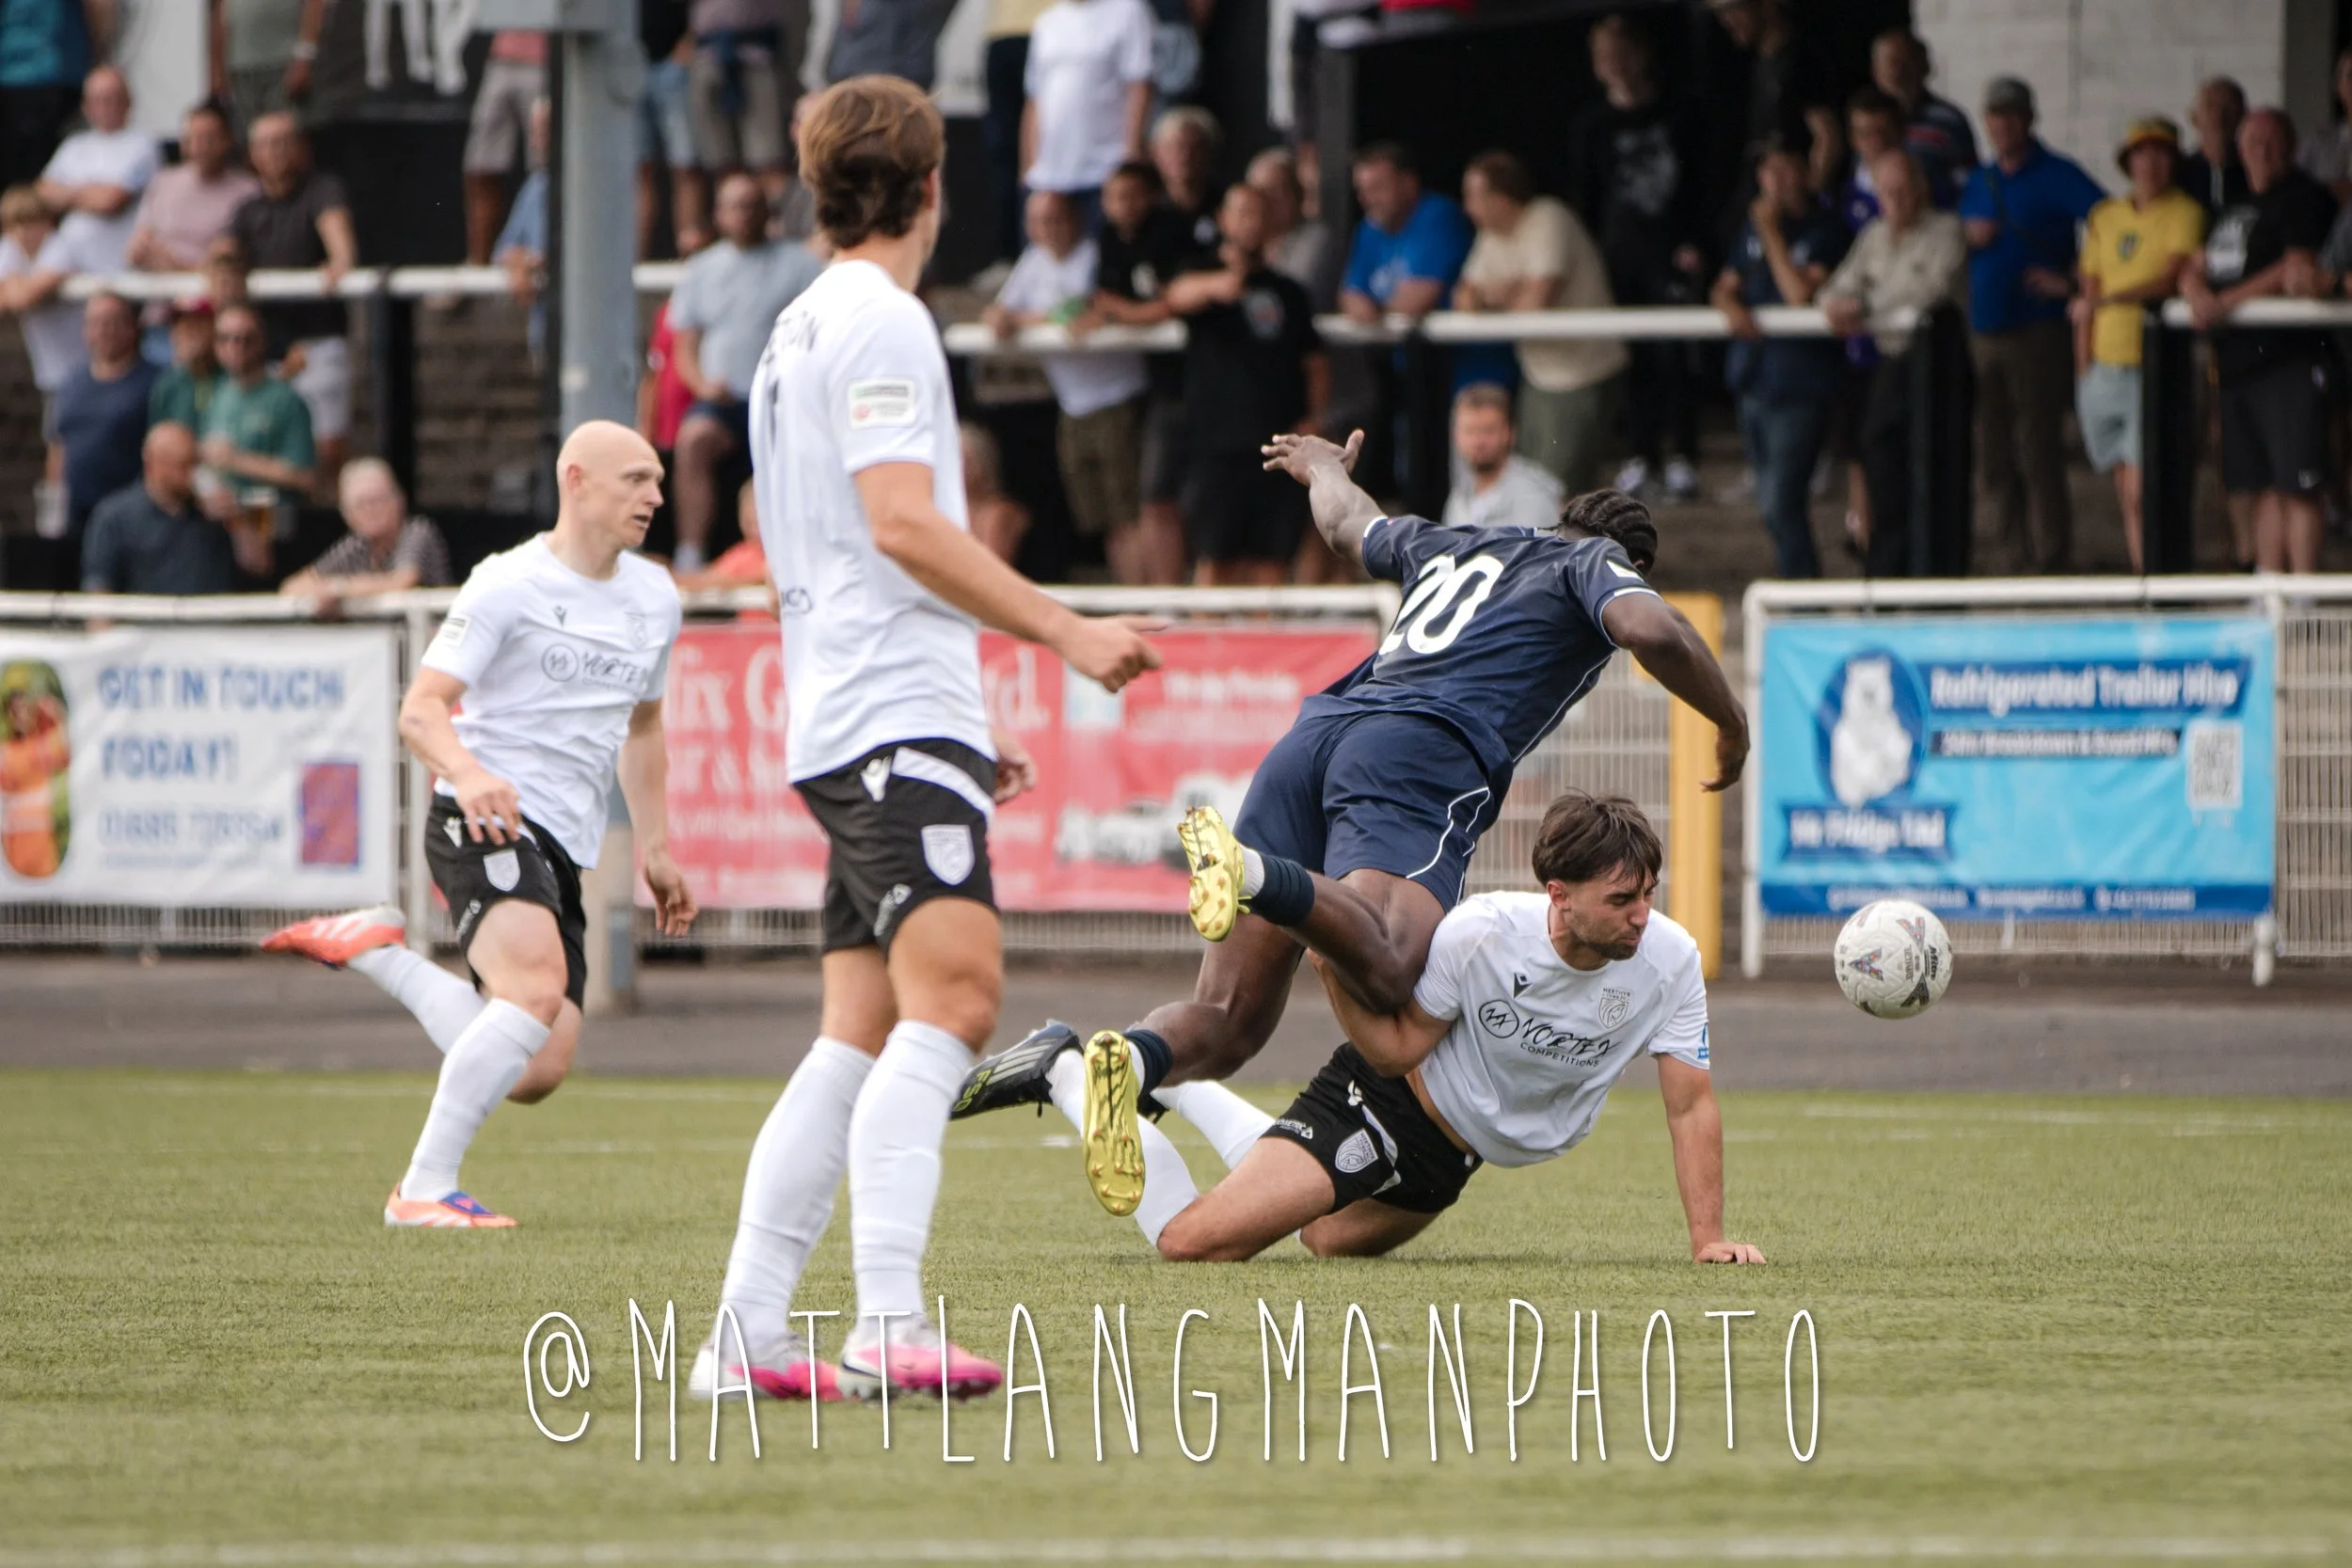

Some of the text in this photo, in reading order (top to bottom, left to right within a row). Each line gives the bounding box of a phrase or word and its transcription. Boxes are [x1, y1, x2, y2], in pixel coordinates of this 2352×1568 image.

[1379, 553, 1505, 656] 20
[98, 666, 344, 711] GET IN TOUCH
[1931, 661, 2238, 718] Refrigerated Trailer Hire
[102, 736, 238, 780] TODAY!
[1520, 1042, 1600, 1068] COMPETITIONS
[1522, 1017, 1622, 1059] VORTEX
